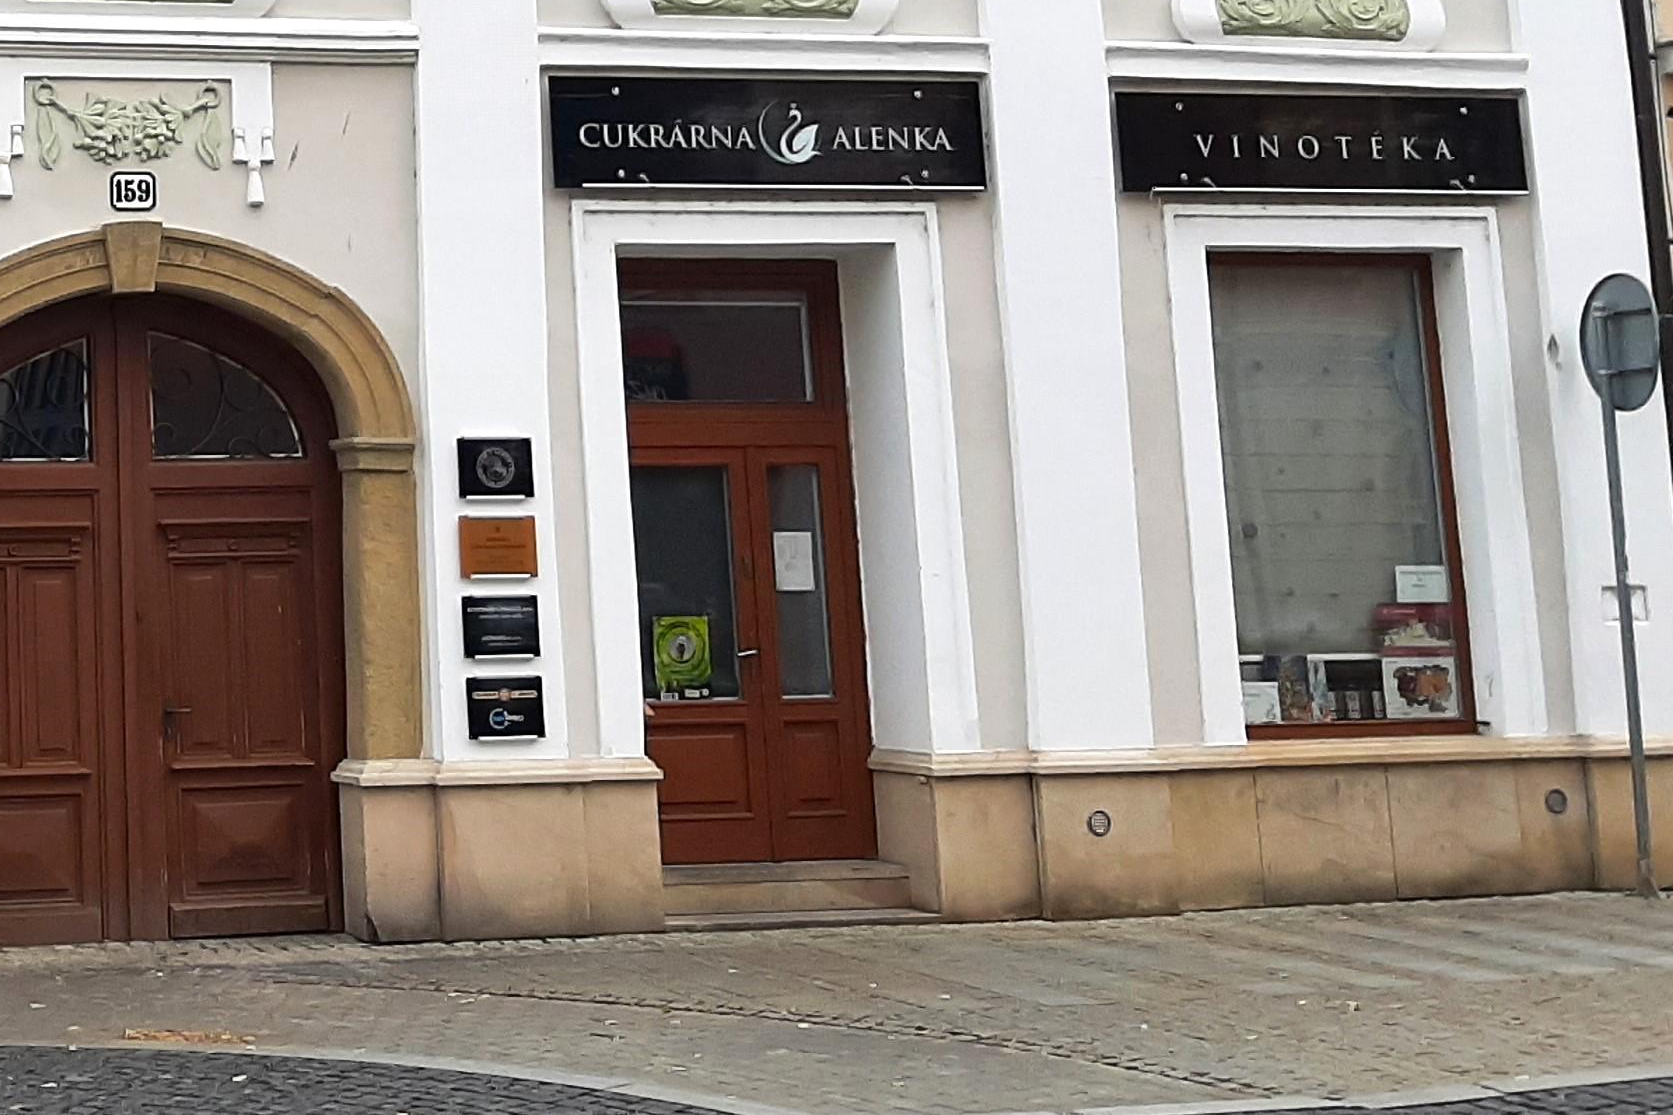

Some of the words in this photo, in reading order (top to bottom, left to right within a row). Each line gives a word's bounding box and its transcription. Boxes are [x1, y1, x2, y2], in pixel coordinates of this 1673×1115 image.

[579, 119, 756, 149] CUKRÁRNA
[832, 125, 954, 151] ALENKA
[1193, 130, 1455, 160] VINOTÉKA
[115, 179, 151, 203] 159
